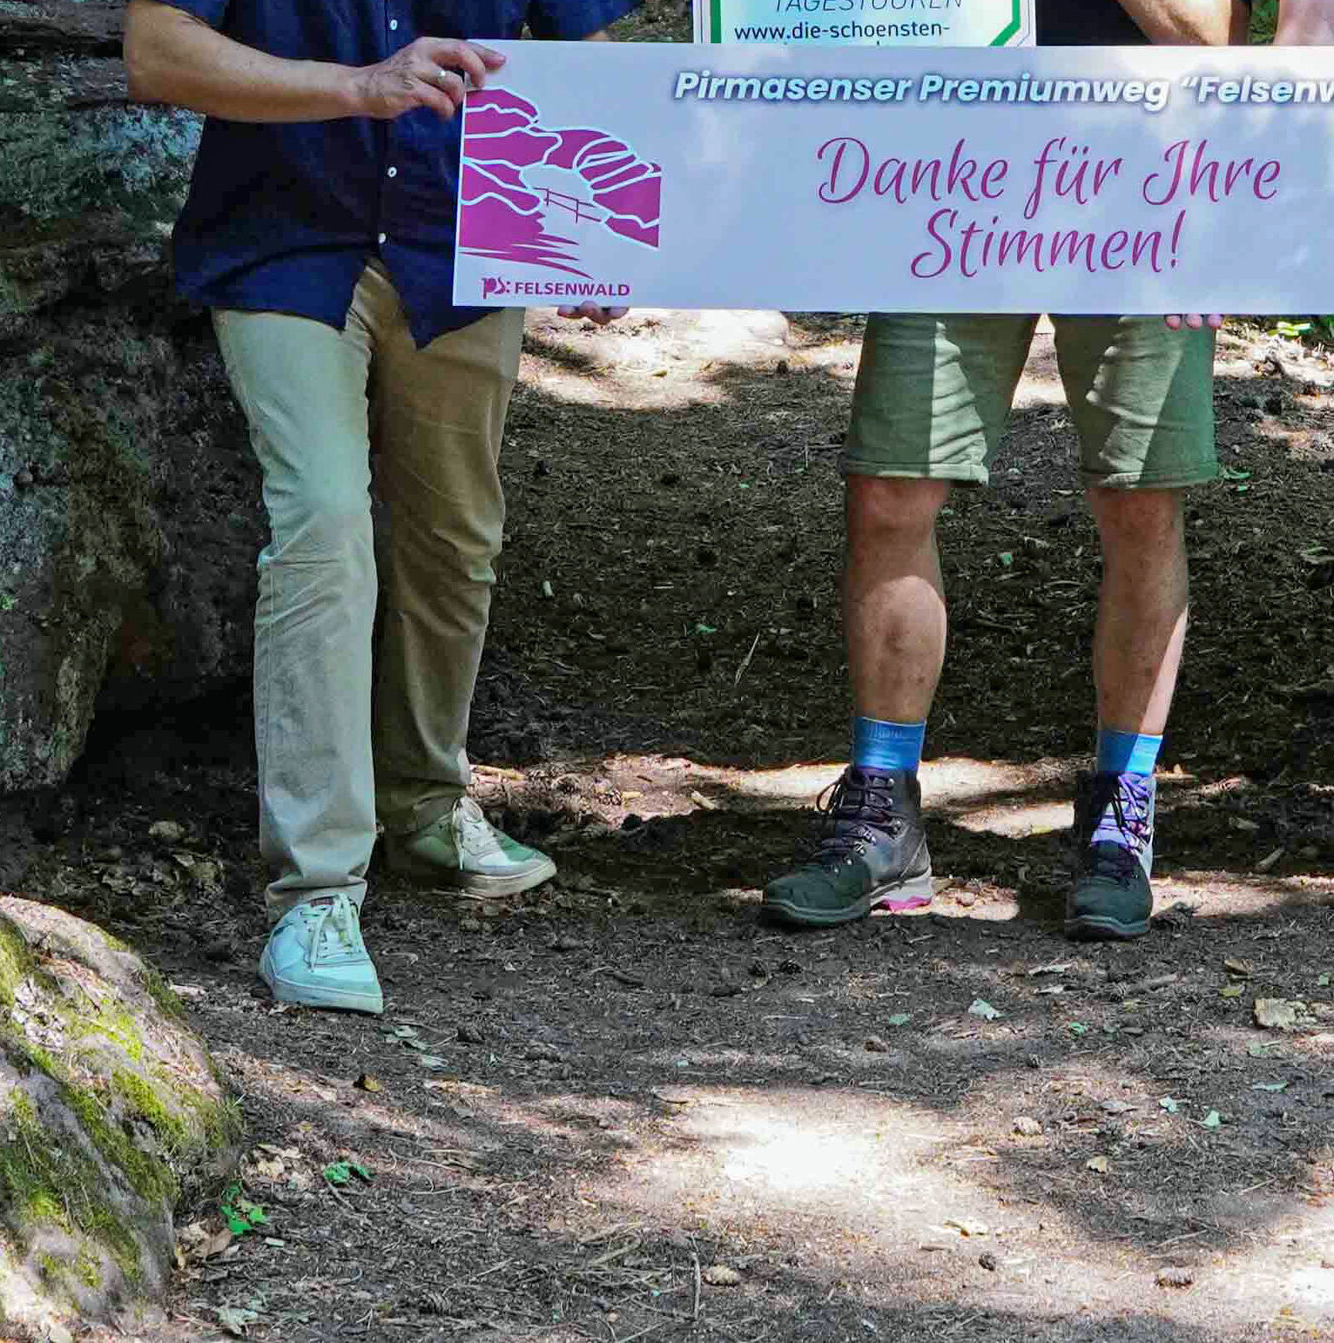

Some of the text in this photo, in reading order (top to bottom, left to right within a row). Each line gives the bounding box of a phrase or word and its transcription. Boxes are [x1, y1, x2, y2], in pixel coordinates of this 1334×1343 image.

[734, 21, 950, 40] www.die-schoensten-
[674, 70, 913, 102] Pirmasenser
[918, 73, 1168, 112] Premiumweg
[817, 137, 1282, 219] Danke für Ihre
[910, 208, 1187, 278] Stimmen!
[514, 282, 631, 296] FELSENWALD
